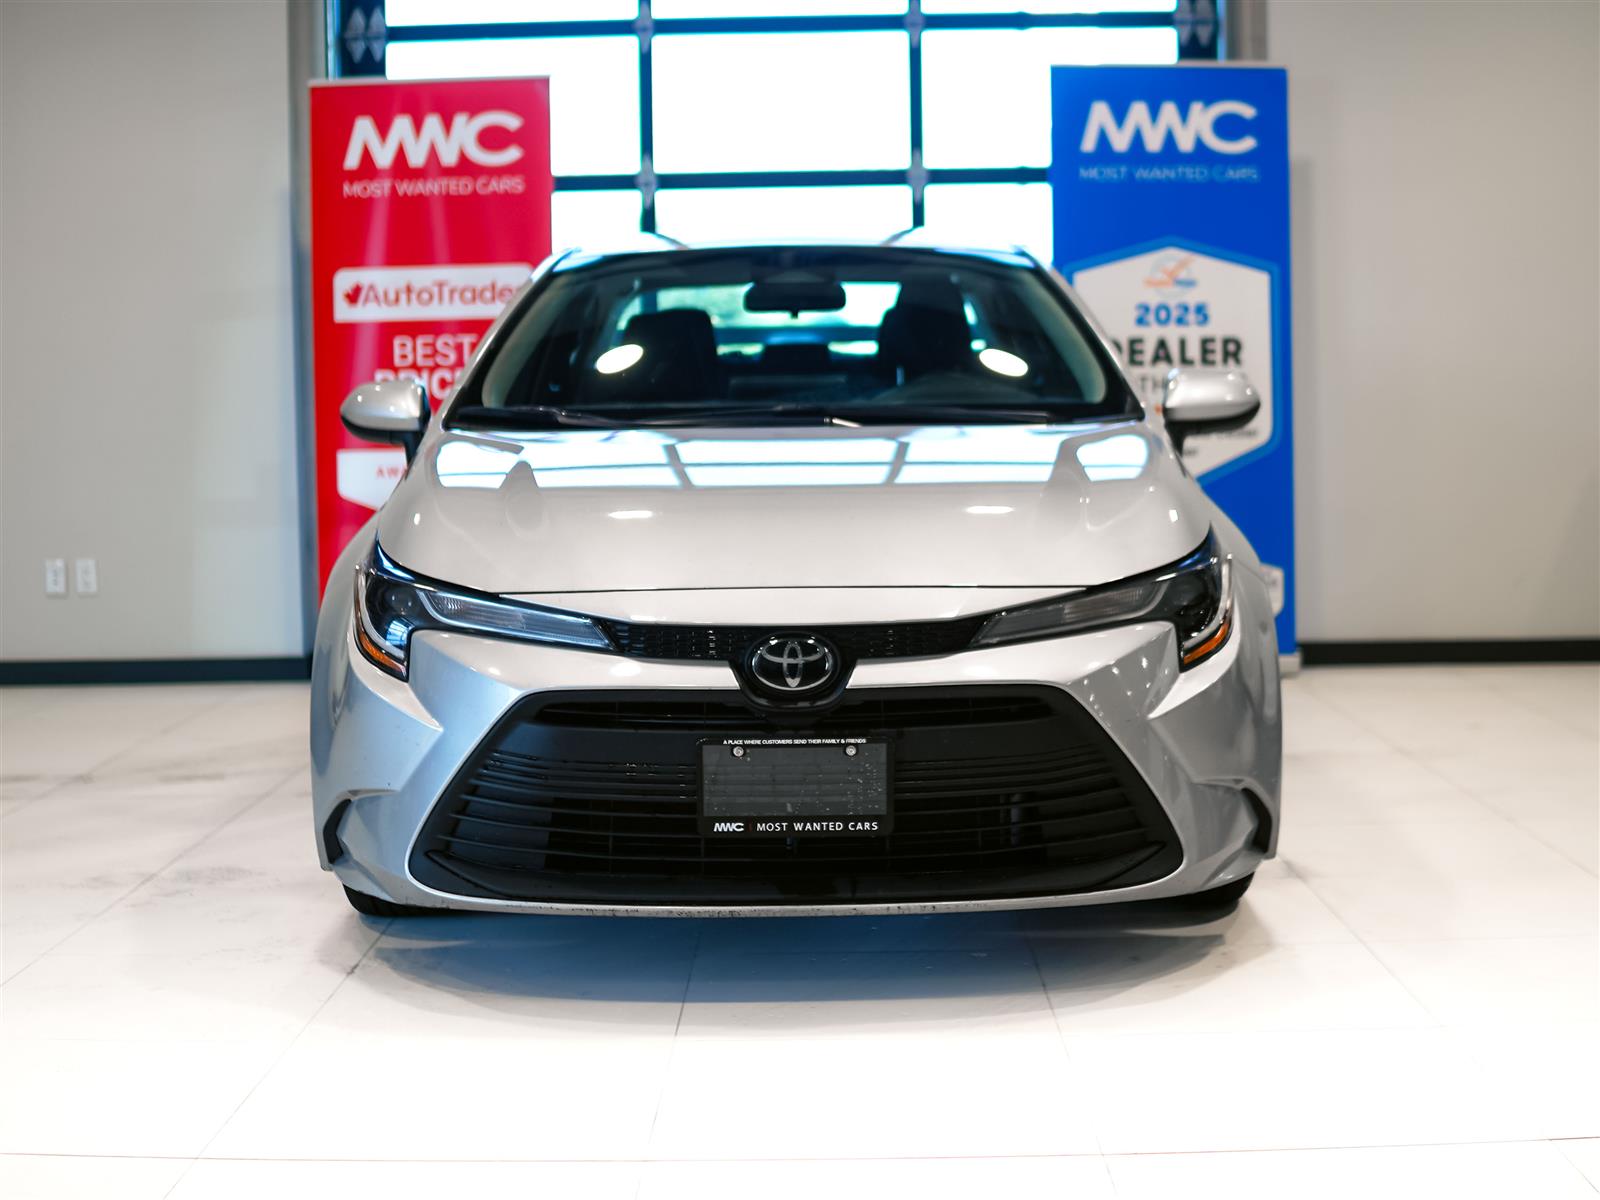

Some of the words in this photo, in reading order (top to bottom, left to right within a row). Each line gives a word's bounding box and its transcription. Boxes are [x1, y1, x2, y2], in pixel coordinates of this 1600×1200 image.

[343, 110, 524, 170] MWC
[1080, 100, 1257, 154] MWC
[343, 179, 392, 198] MOST
[395, 175, 473, 197] WANTED
[475, 174, 525, 195] CARS
[1134, 302, 1210, 326] 2025
[393, 333, 478, 367] BEST
[713, 822, 745, 832] MWC
[756, 822, 788, 832] MOST
[793, 821, 843, 831] WANTED
[848, 821, 879, 831] CARS
